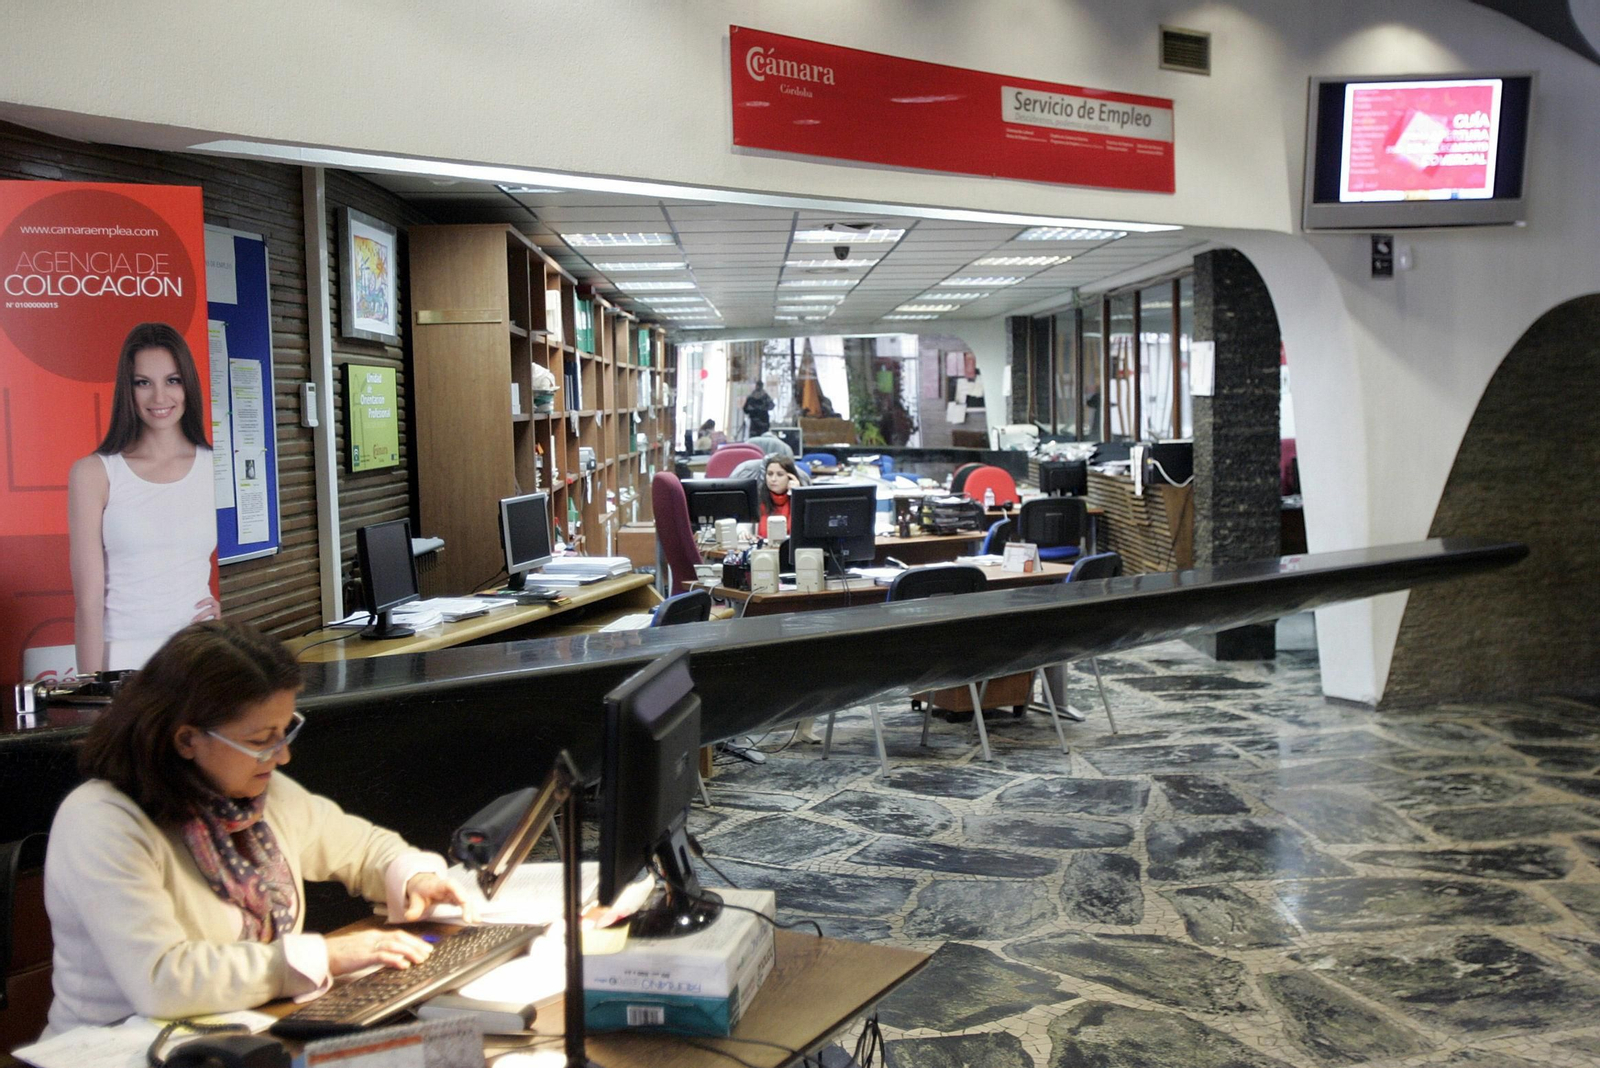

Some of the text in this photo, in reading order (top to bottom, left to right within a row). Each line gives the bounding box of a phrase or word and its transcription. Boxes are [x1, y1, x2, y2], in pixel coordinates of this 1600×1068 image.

[780, 83, 813, 98] Córdoba
[1014, 92, 1074, 118] Servicio
[1077, 101, 1095, 120] de
[1099, 104, 1152, 129] Empleo
[1452, 110, 1490, 128] GUÍA
[20, 225, 159, 238] www.camaraemplea.com
[14, 251, 169, 275] AGENCIA DE
[4, 271, 183, 298] COLOCACIÓN
